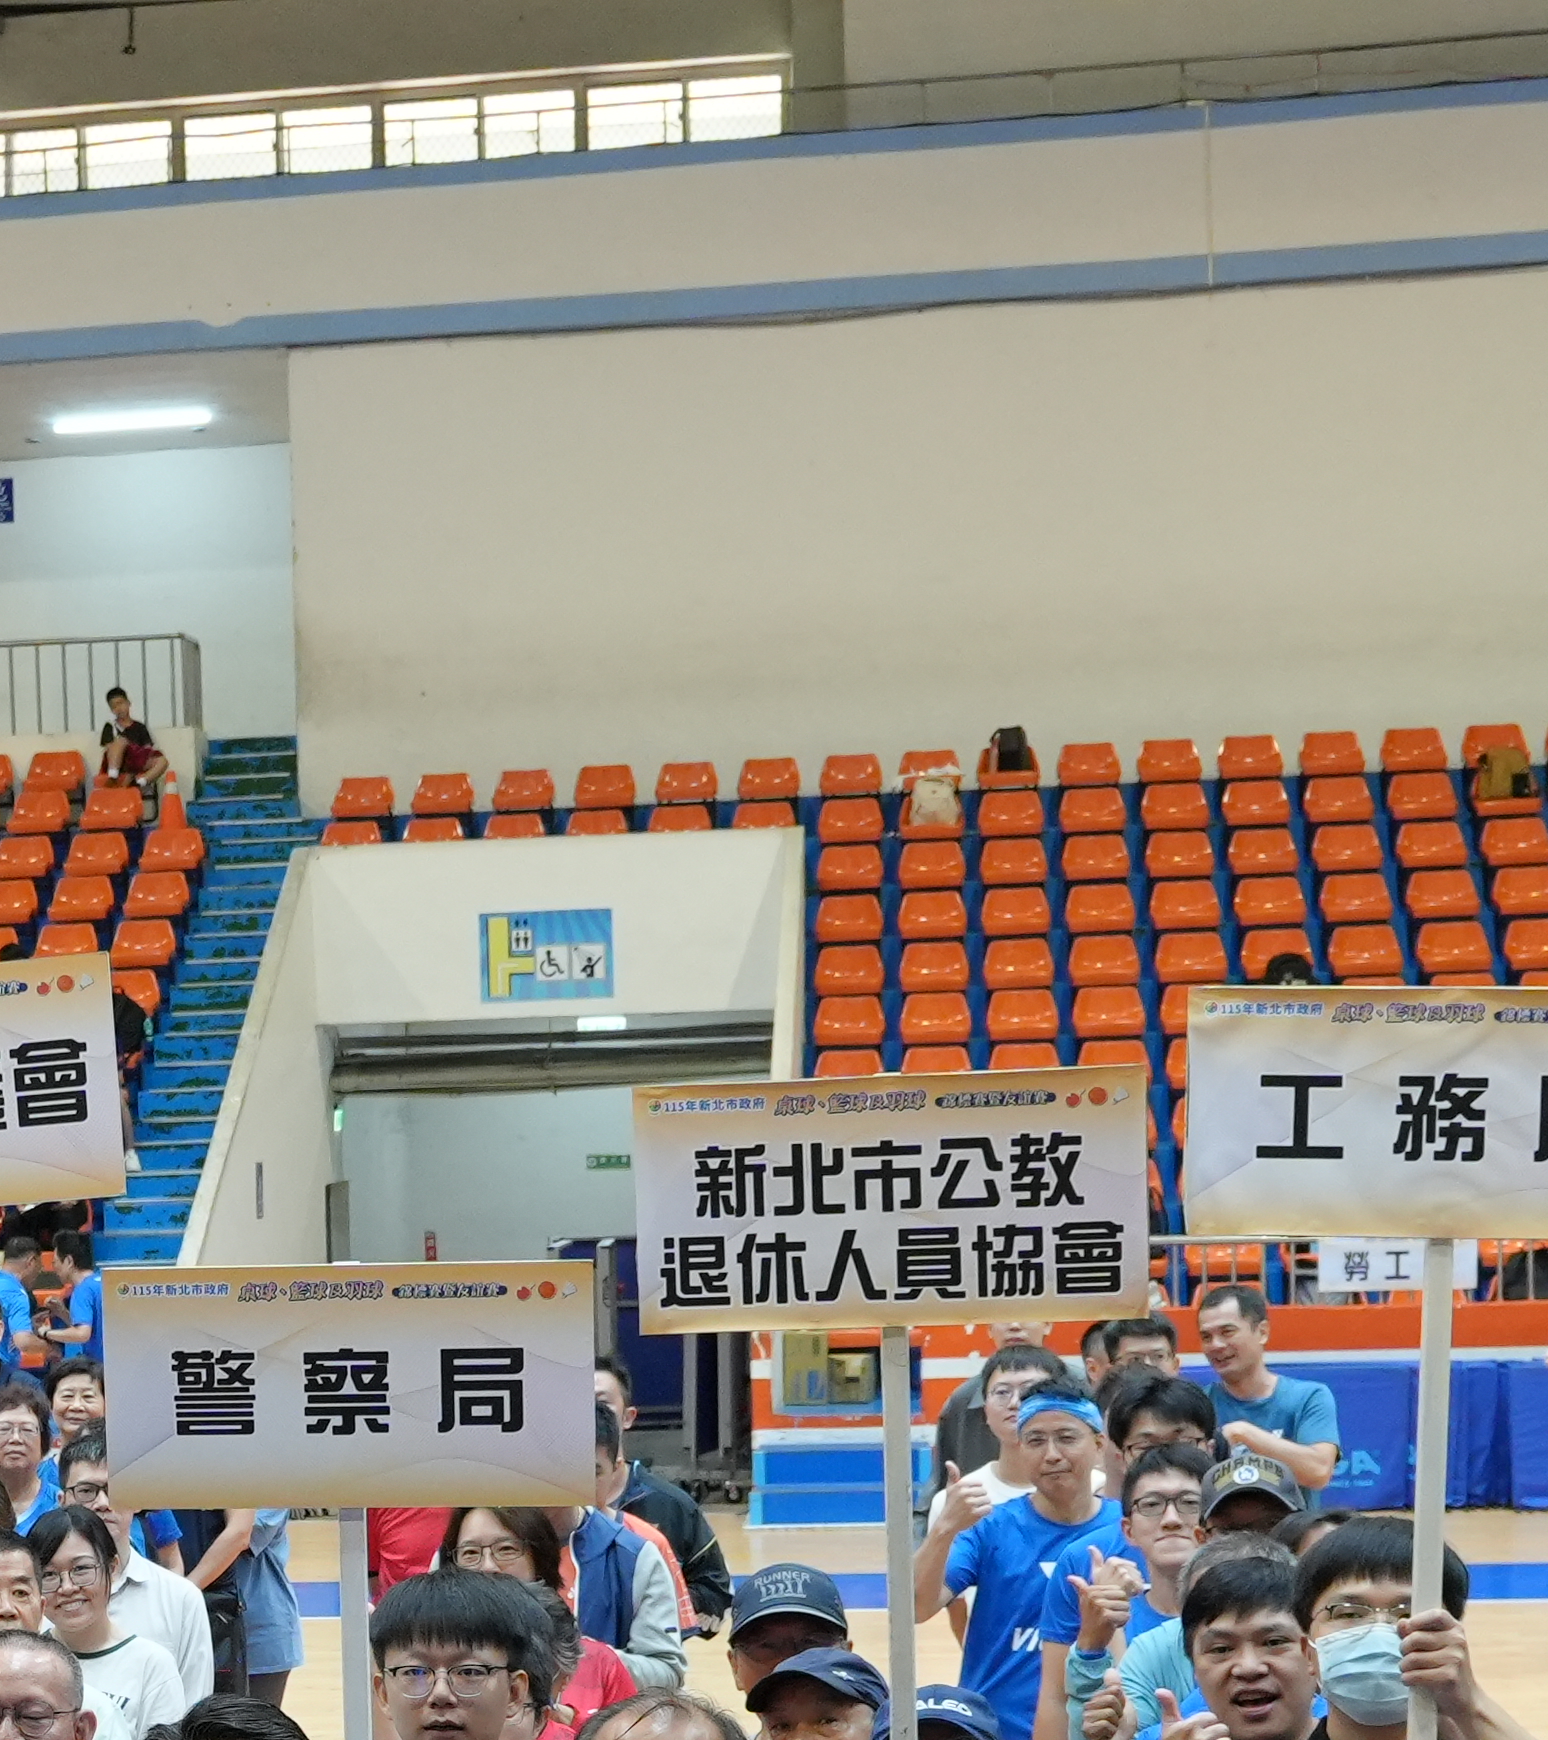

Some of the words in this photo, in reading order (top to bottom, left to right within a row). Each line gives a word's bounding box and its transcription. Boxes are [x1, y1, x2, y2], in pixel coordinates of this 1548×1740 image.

[1221, 1003, 1323, 1017] 115年新北市政府
[664, 1096, 766, 1112] 115年新北市政府
[693, 1131, 1085, 1218] 新北市公教
[658, 1219, 1124, 1311] 退休人員協會
[131, 1284, 229, 1297] 115年新北市政府
[170, 1347, 524, 1438] 警察局
[754, 1571, 811, 1589] RUNNER
